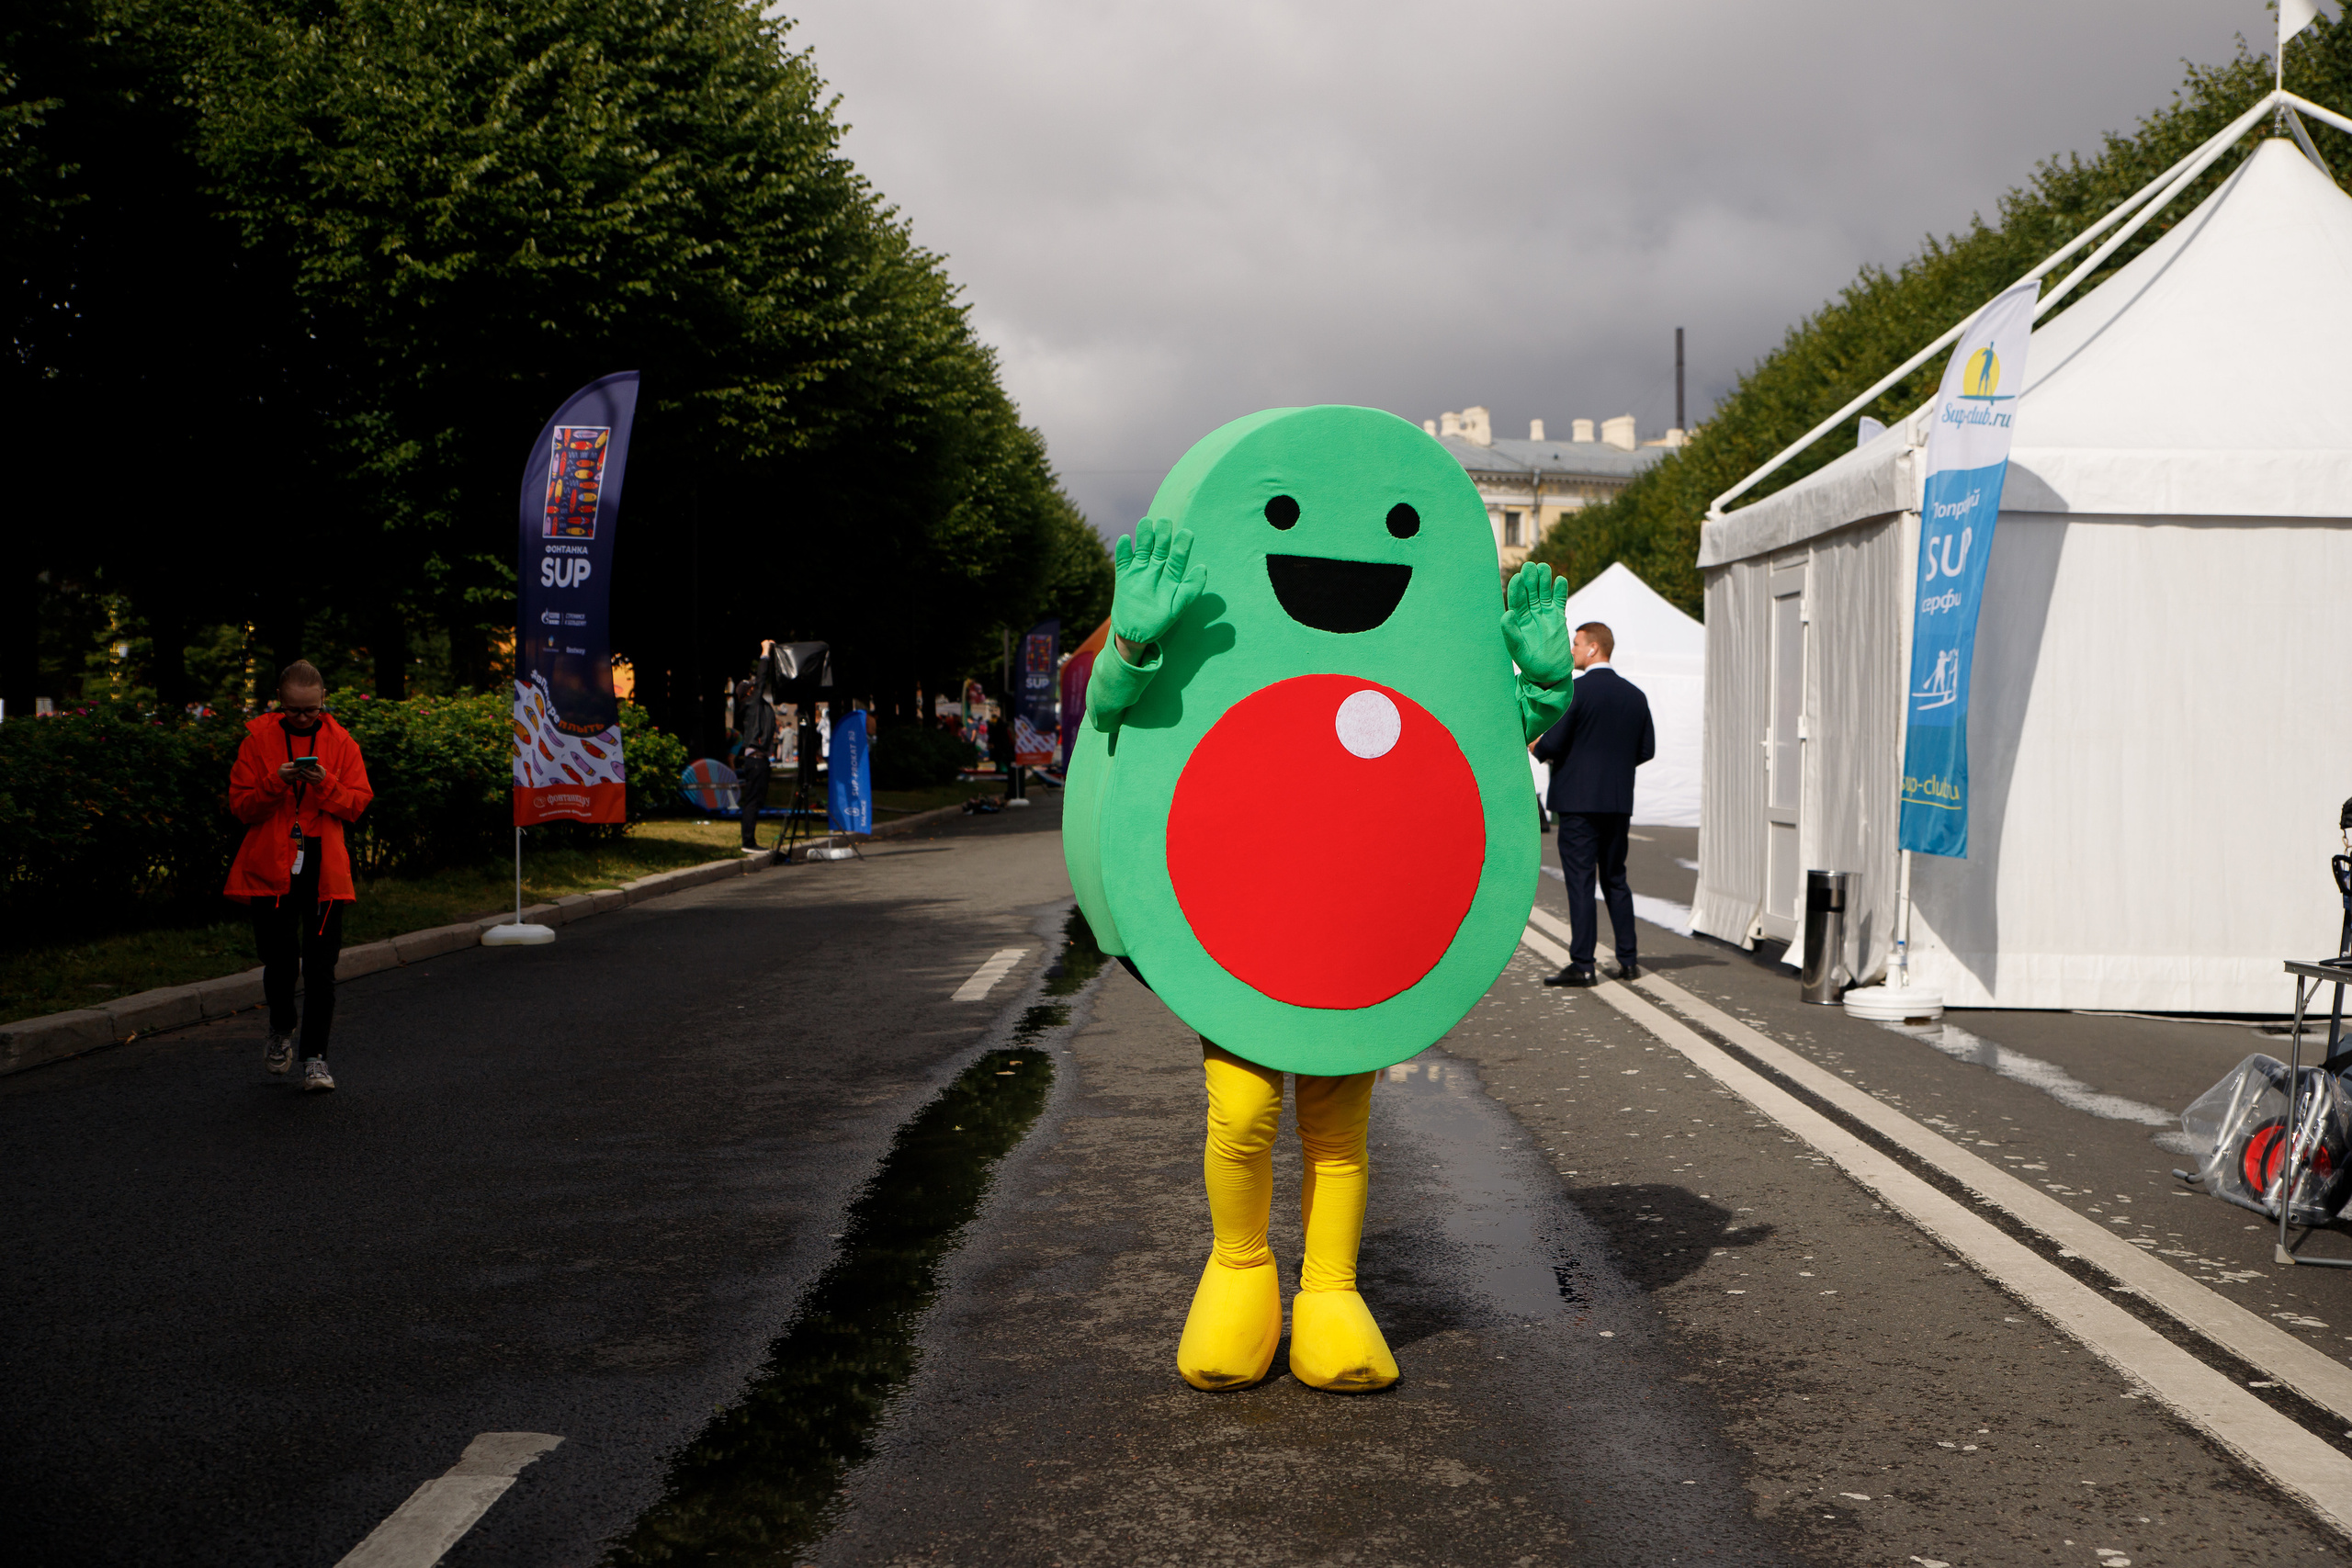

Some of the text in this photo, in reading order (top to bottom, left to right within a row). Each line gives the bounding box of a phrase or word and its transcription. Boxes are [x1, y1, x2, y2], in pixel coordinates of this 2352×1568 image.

[545, 545, 589, 555] ФОНТАНКА
[540, 557, 592, 588] SUP
[1025, 677, 1050, 689] SUP
